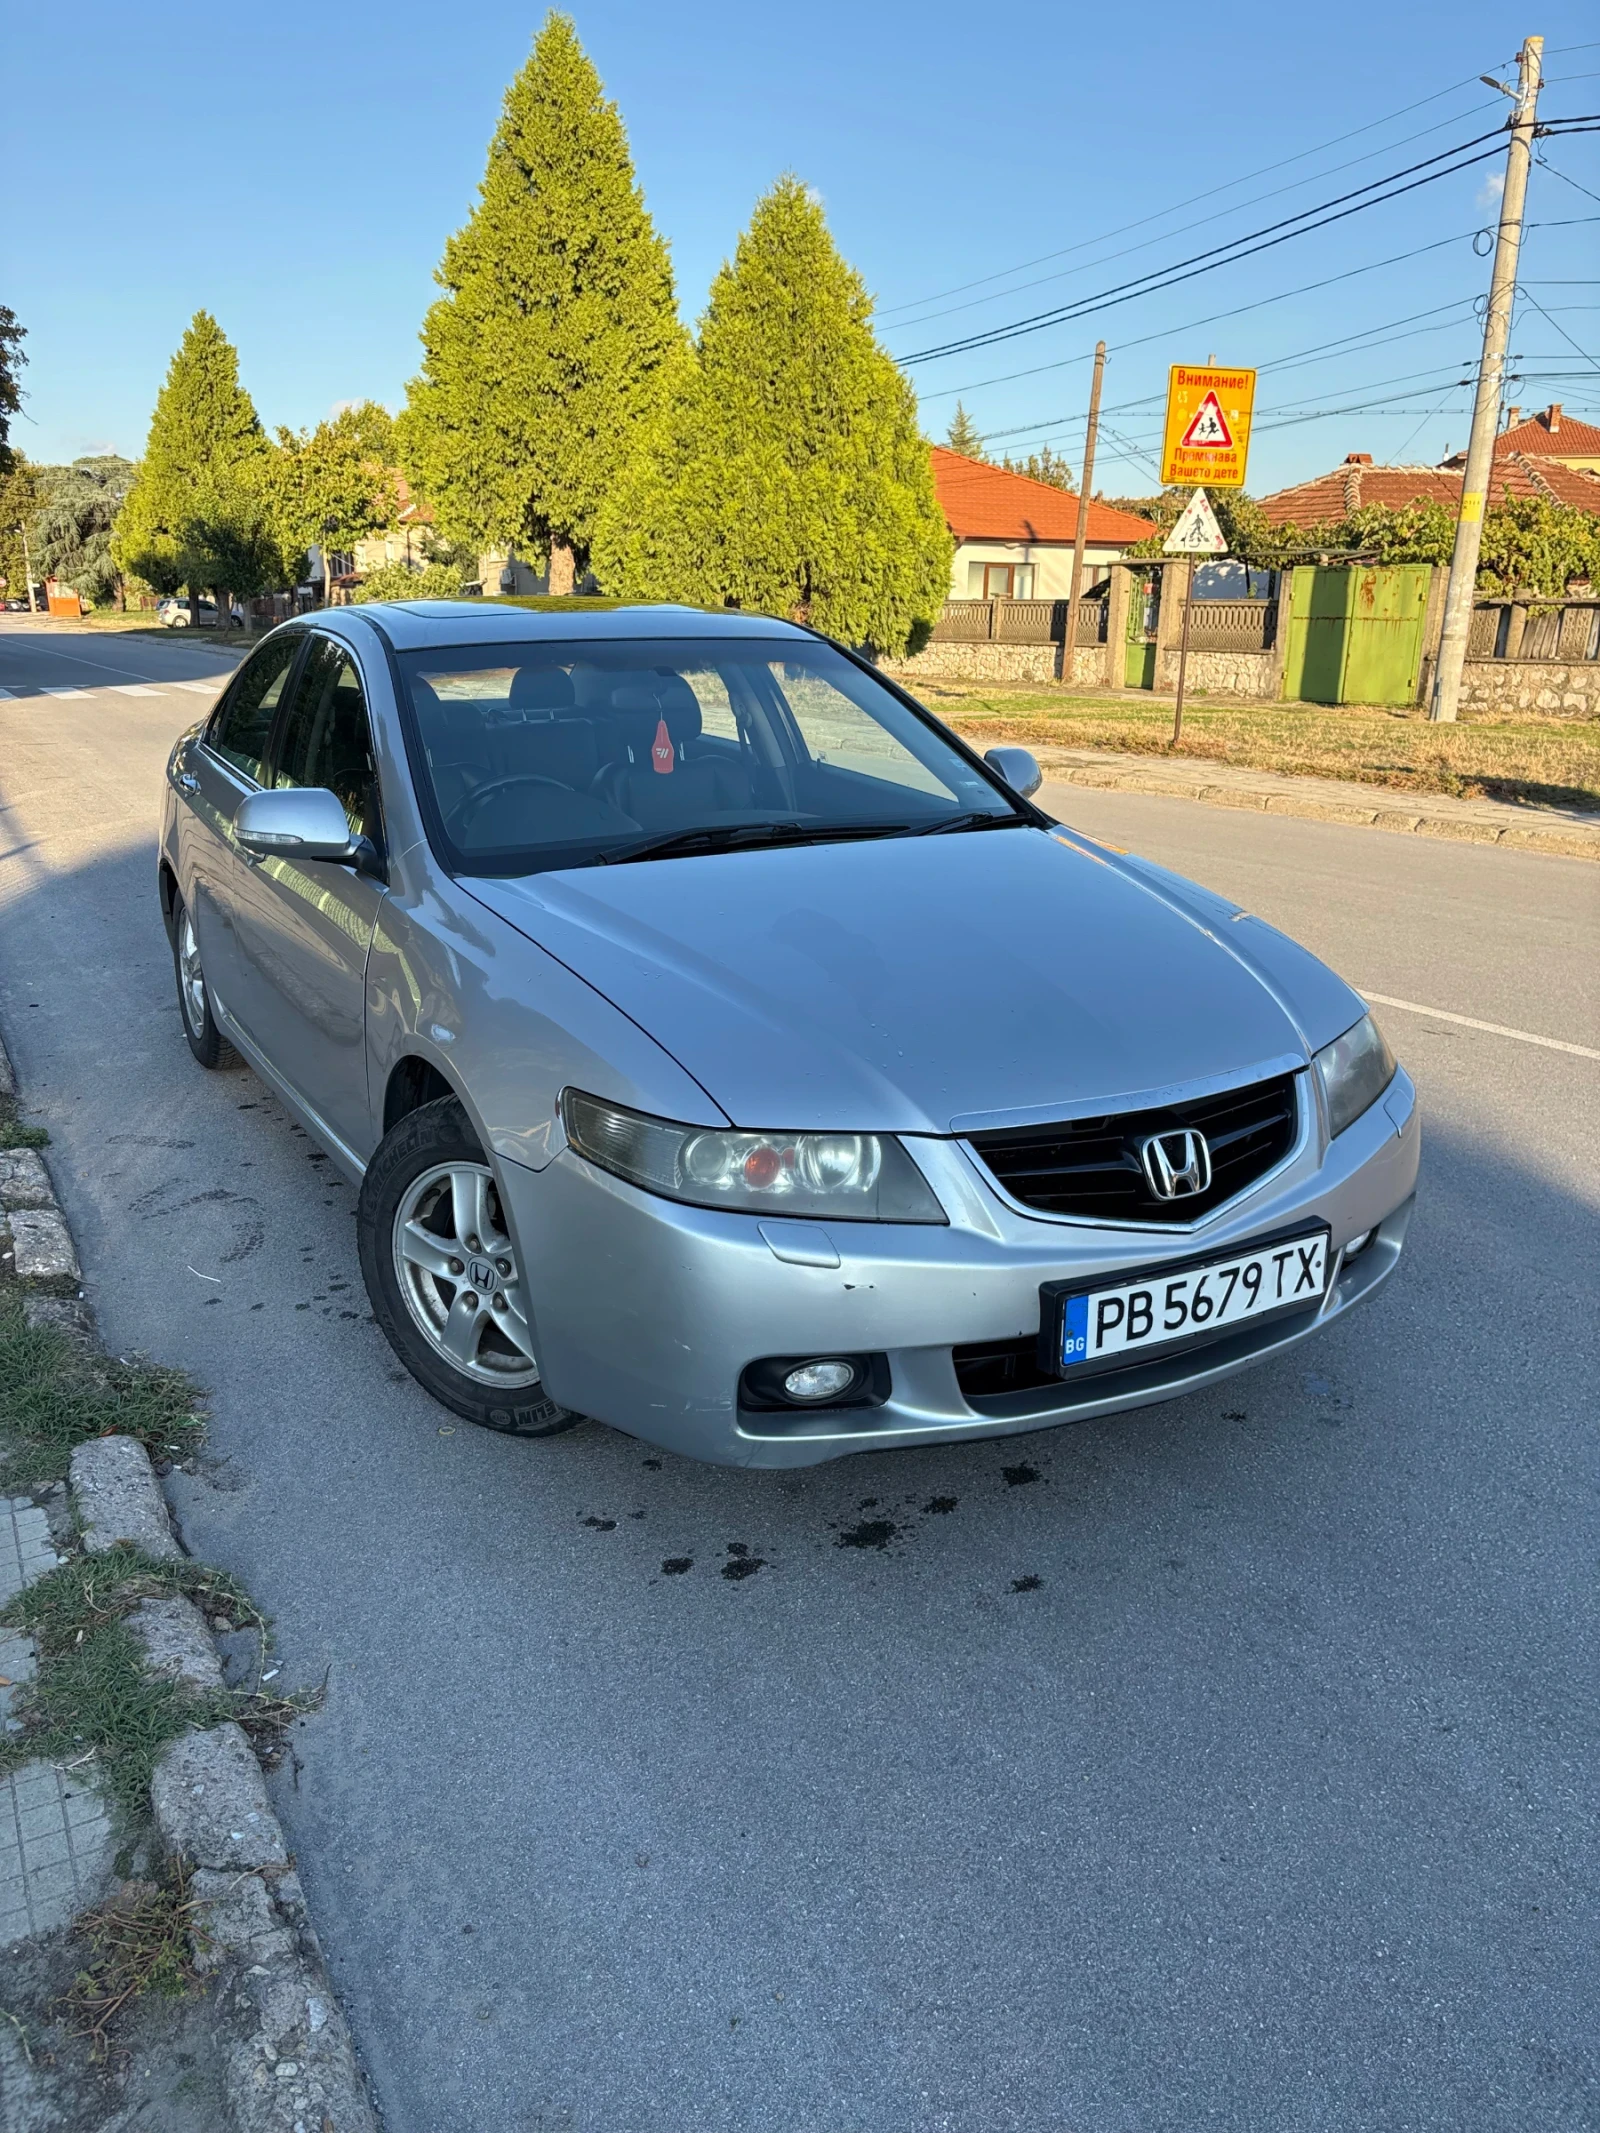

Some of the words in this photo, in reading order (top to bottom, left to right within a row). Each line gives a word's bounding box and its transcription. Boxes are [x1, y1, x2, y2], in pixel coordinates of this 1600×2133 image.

[1177, 369, 1249, 389] Внимание!
[1169, 463, 1211, 478] Вашето
[1213, 468, 1238, 480] дете
[1163, 1261, 1263, 1331] 5679
[1065, 1336, 1085, 1355] BG
